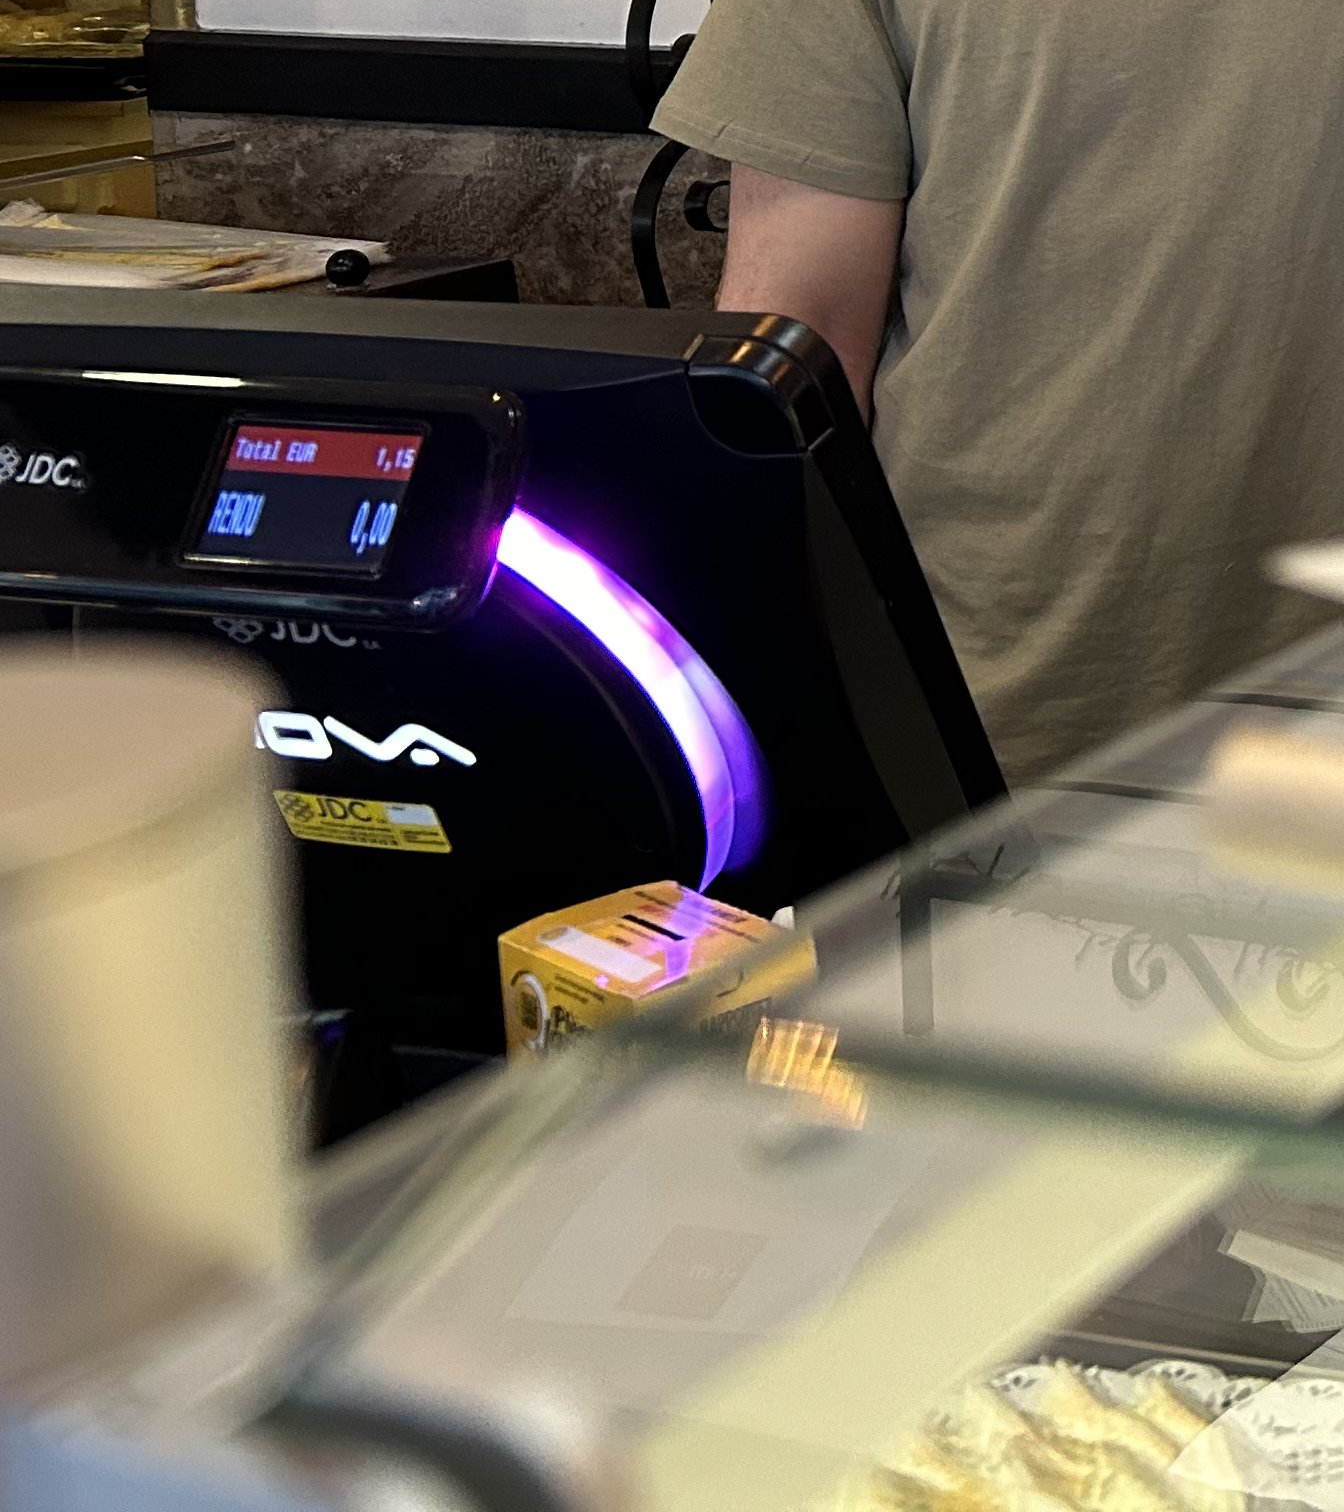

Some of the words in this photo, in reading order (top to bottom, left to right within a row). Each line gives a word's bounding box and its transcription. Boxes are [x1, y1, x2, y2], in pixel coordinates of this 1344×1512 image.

[15, 454, 79, 486] JDC
[236, 438, 281, 461] Total
[286, 441, 318, 463] EUR
[376, 448, 416, 472] 1,15
[208, 490, 266, 537] RENDU
[350, 500, 398, 555] 0,00
[316, 797, 372, 822] JDC
